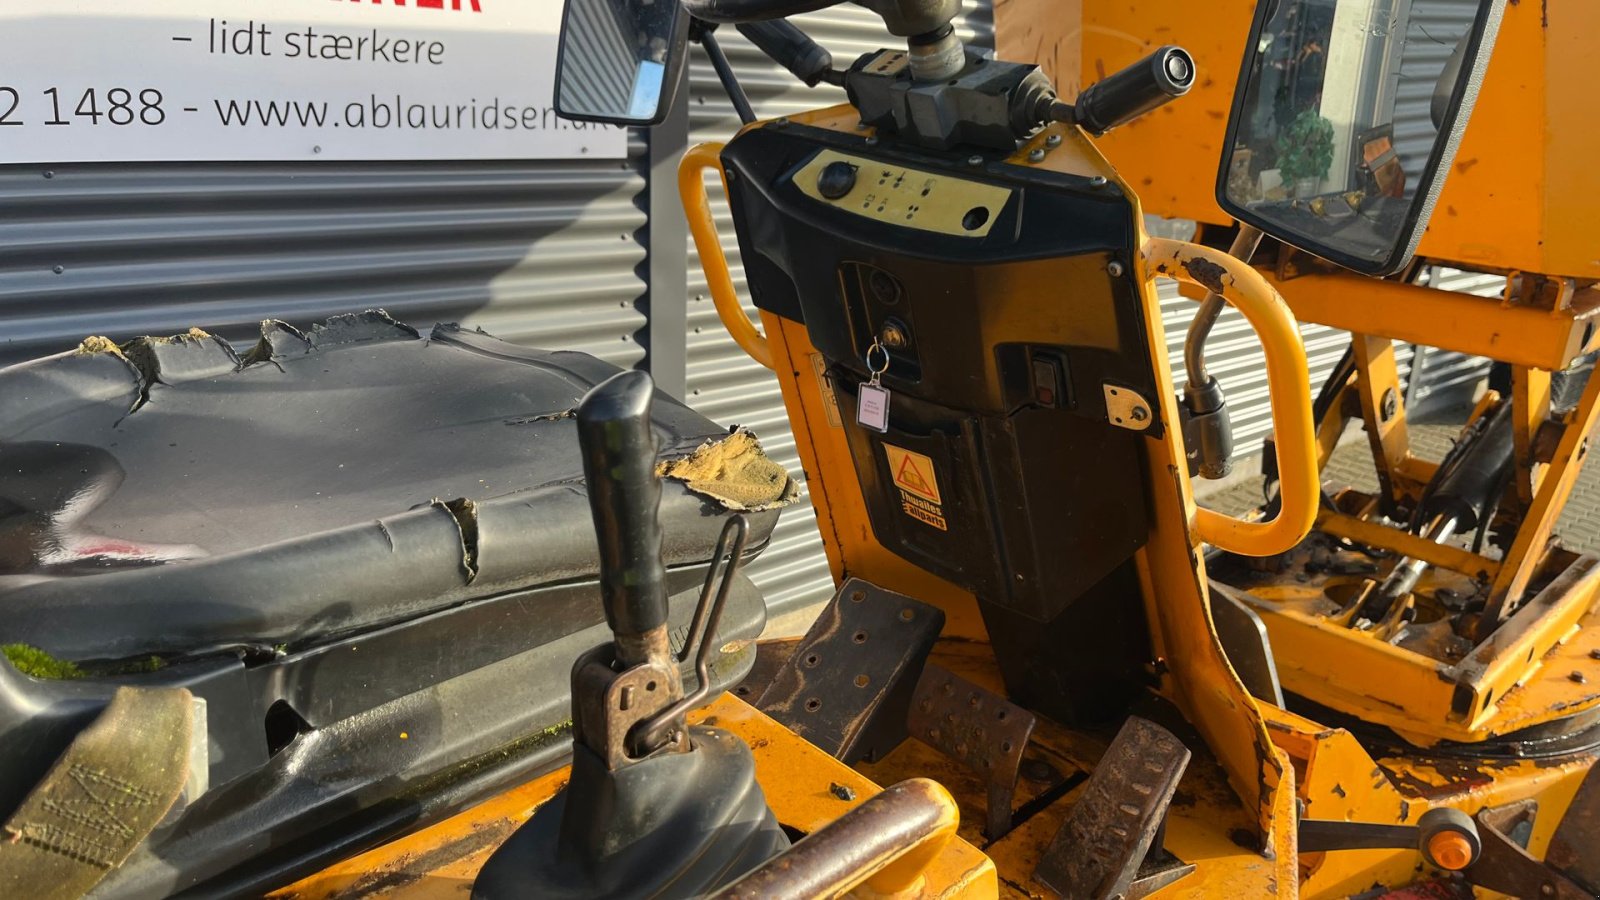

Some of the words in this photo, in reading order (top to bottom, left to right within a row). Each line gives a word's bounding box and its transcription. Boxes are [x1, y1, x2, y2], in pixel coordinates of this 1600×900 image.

[210, 18, 272, 56] lidt
[284, 26, 445, 65] stærkere
[43, 87, 166, 126] 1488
